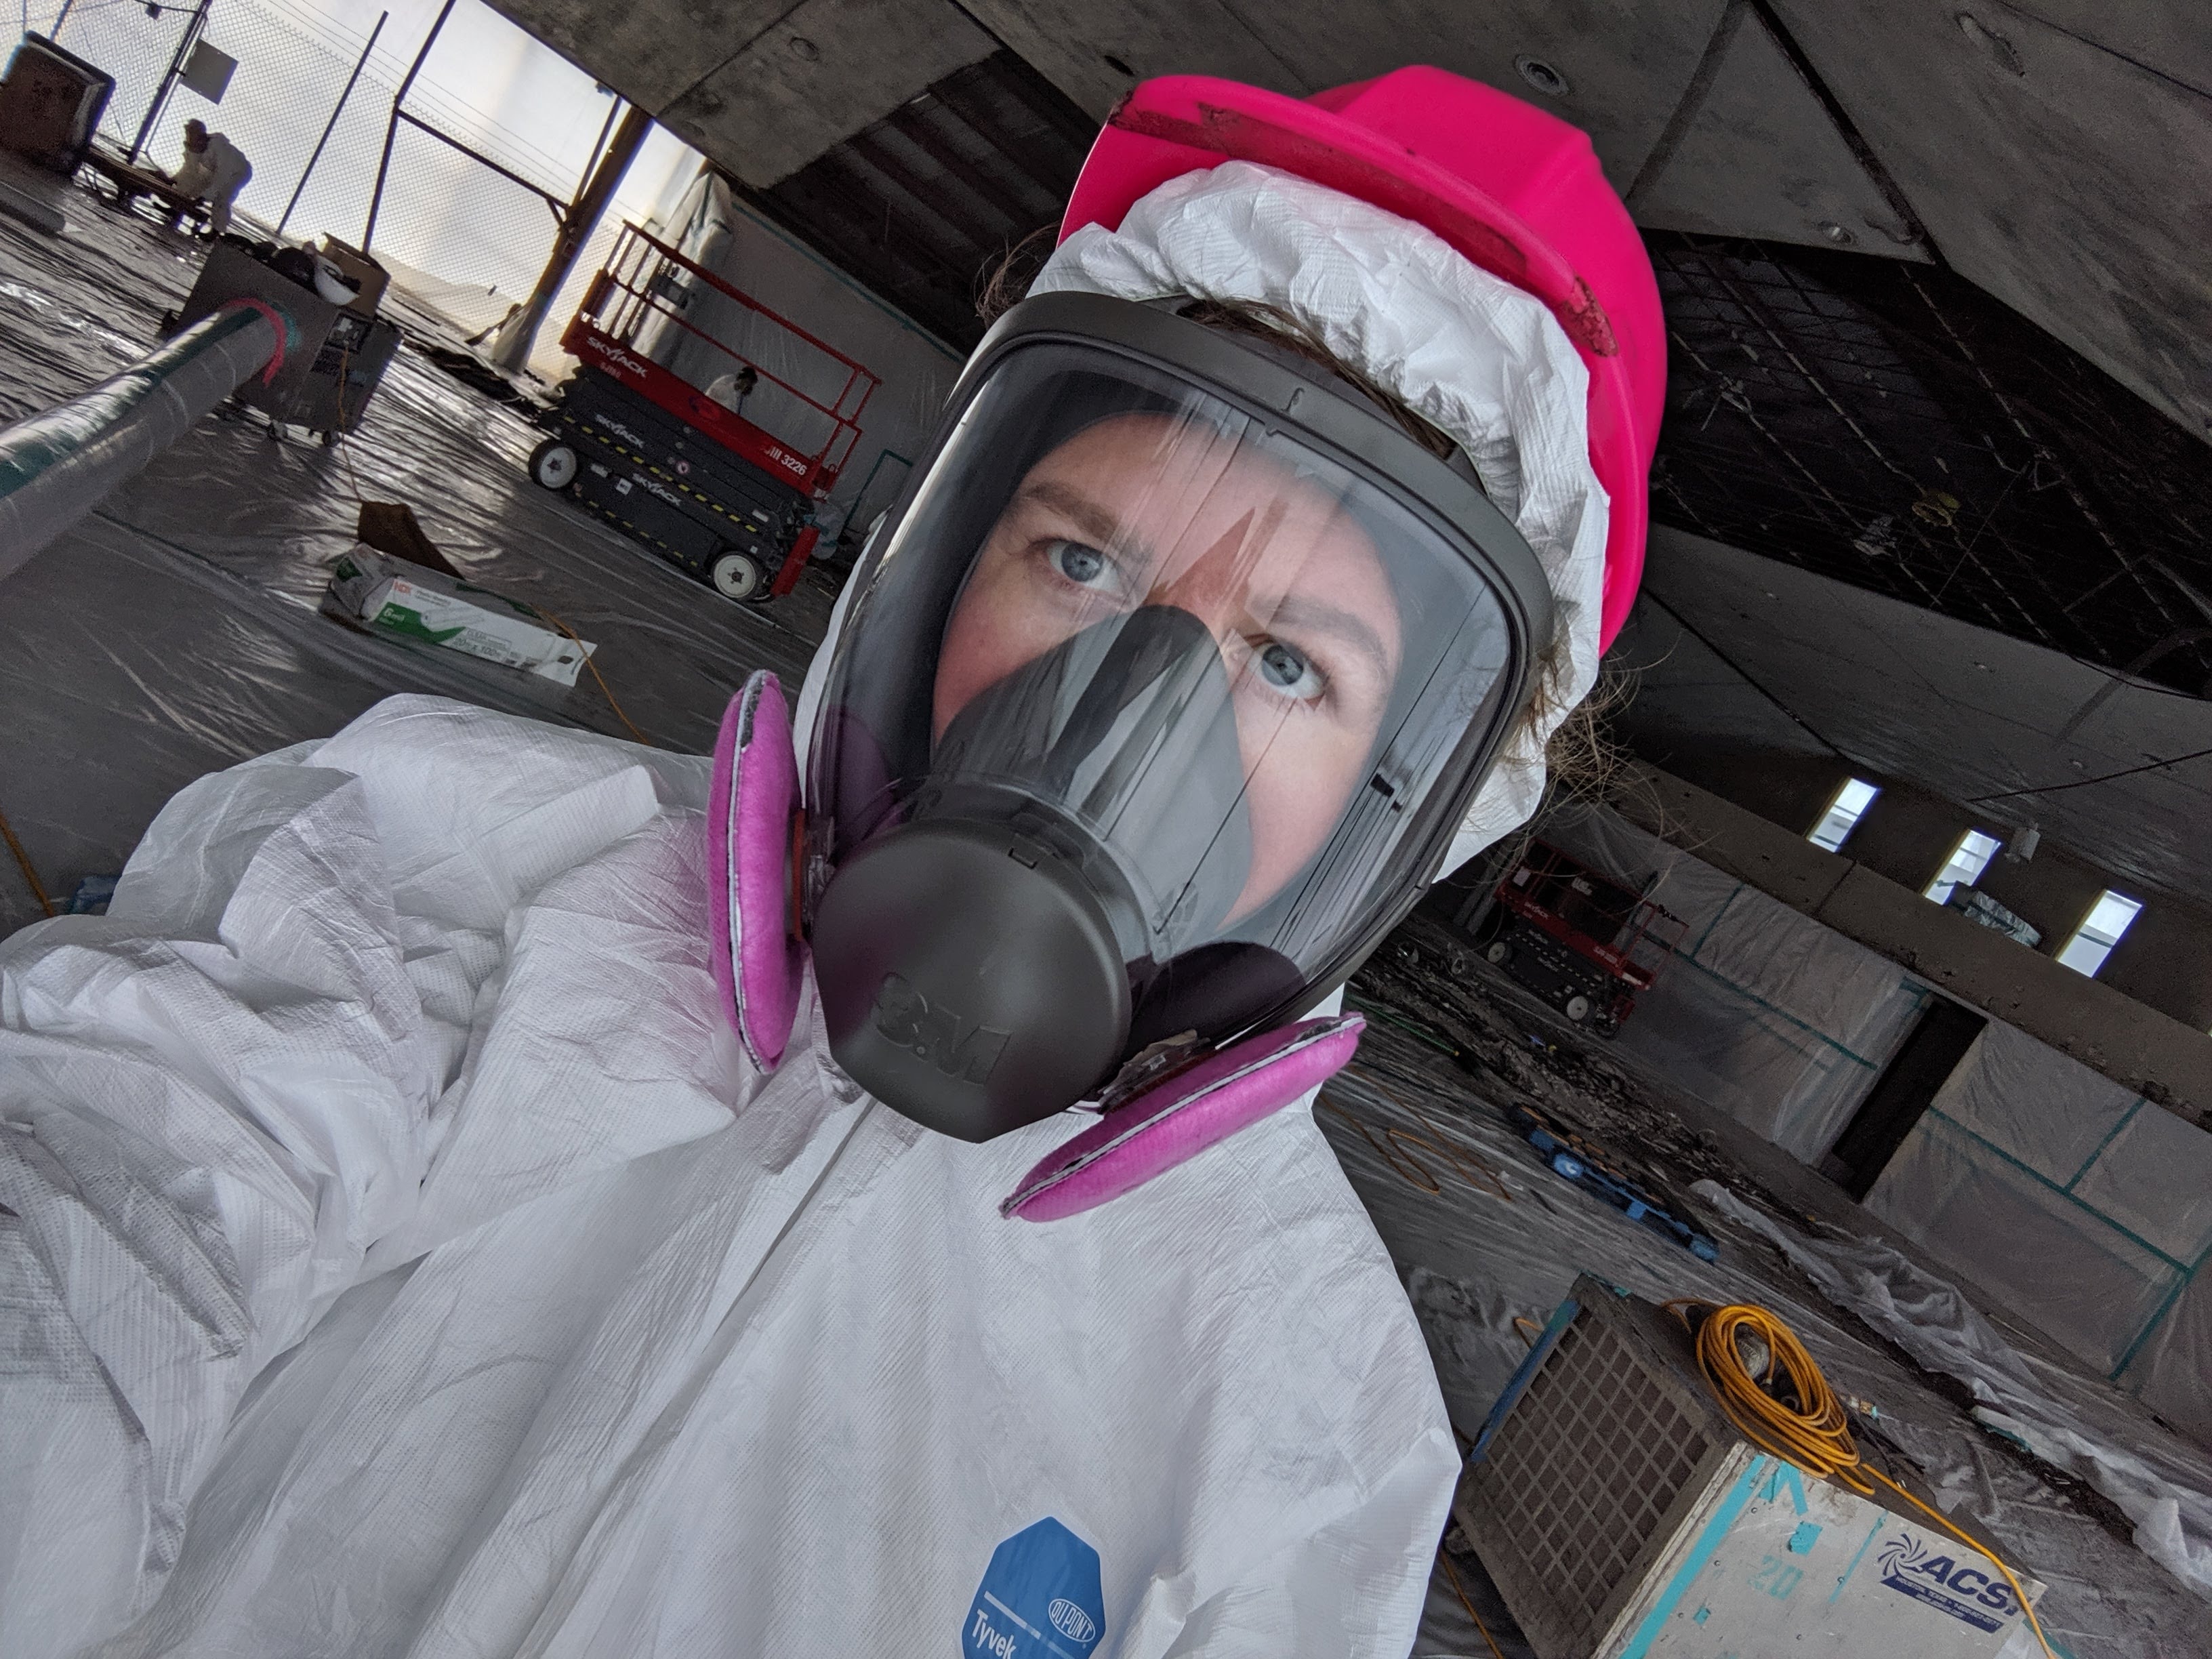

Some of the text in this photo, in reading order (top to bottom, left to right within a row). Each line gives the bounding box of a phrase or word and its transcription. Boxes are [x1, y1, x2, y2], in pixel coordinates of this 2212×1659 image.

[587, 336, 649, 378] SKYJACK
[594, 411, 644, 449] SKYJACK
[781, 454, 807, 476] 3226
[632, 473, 682, 506] SKYJACK
[872, 972, 1015, 1086] 3M
[1746, 1554, 1804, 1600] 20
[972, 1608, 1016, 1659] Tyvek
